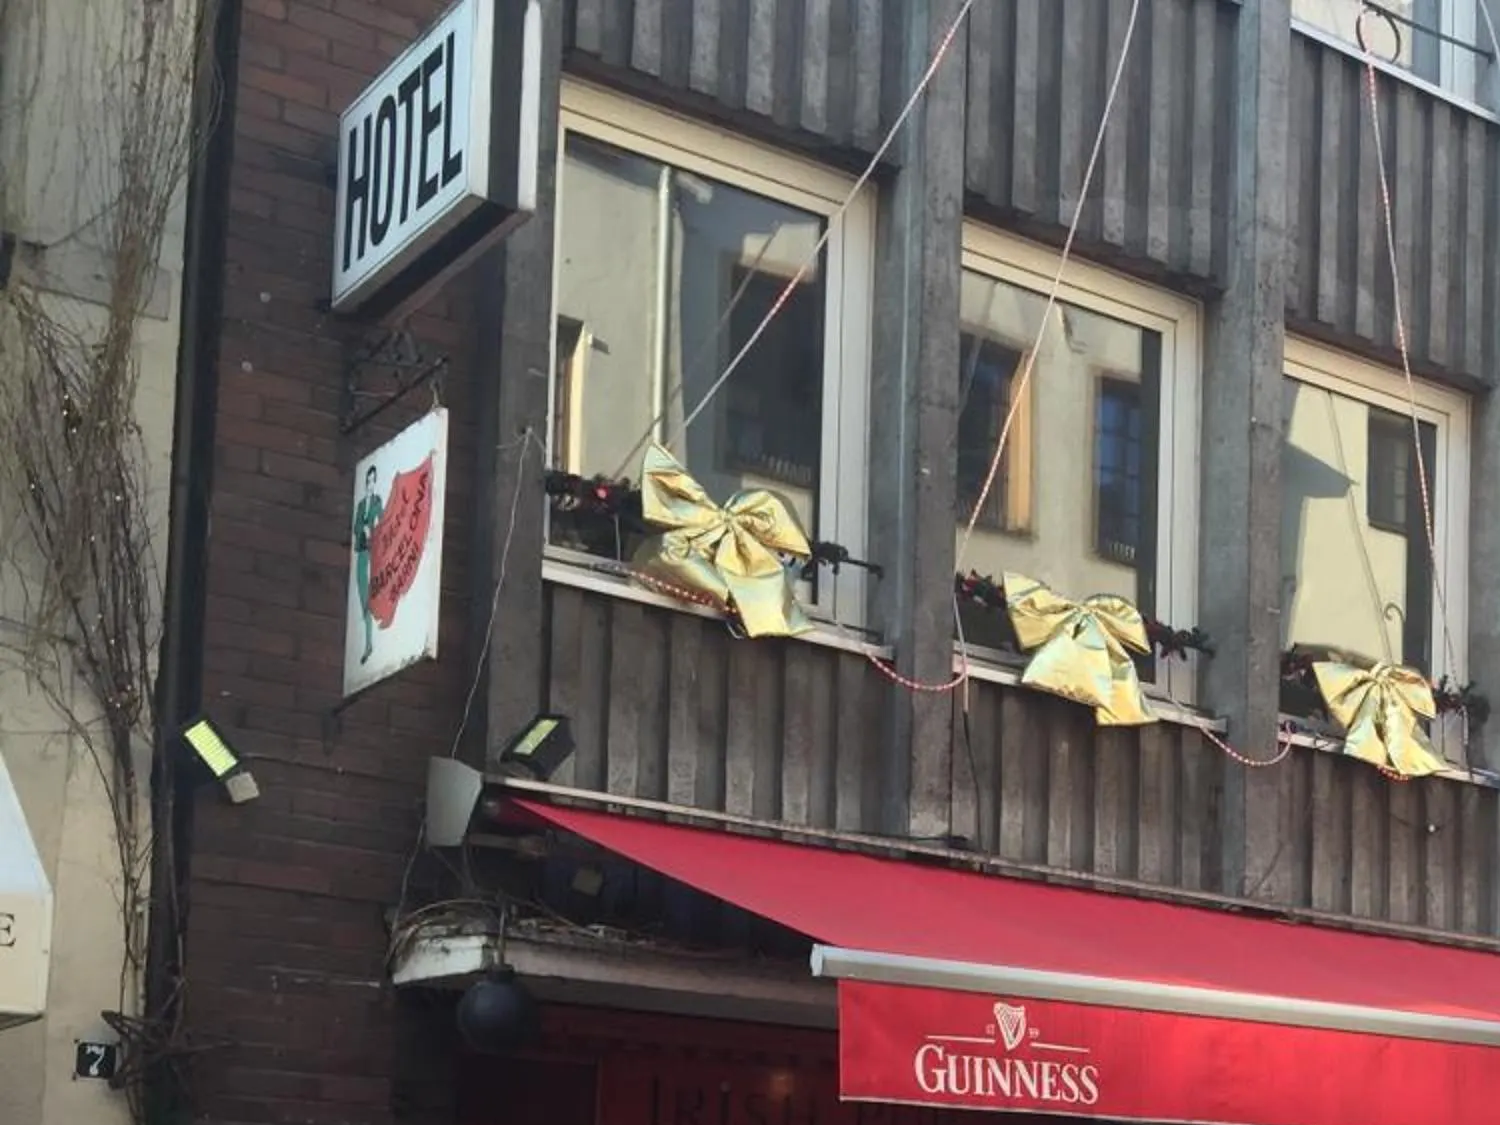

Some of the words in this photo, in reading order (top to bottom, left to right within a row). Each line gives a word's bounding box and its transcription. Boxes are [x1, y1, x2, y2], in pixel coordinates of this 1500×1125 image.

[342, 31, 463, 273] HOTEL
[86, 1045, 105, 1076] 7
[914, 1043, 1099, 1105] GUINNESS
